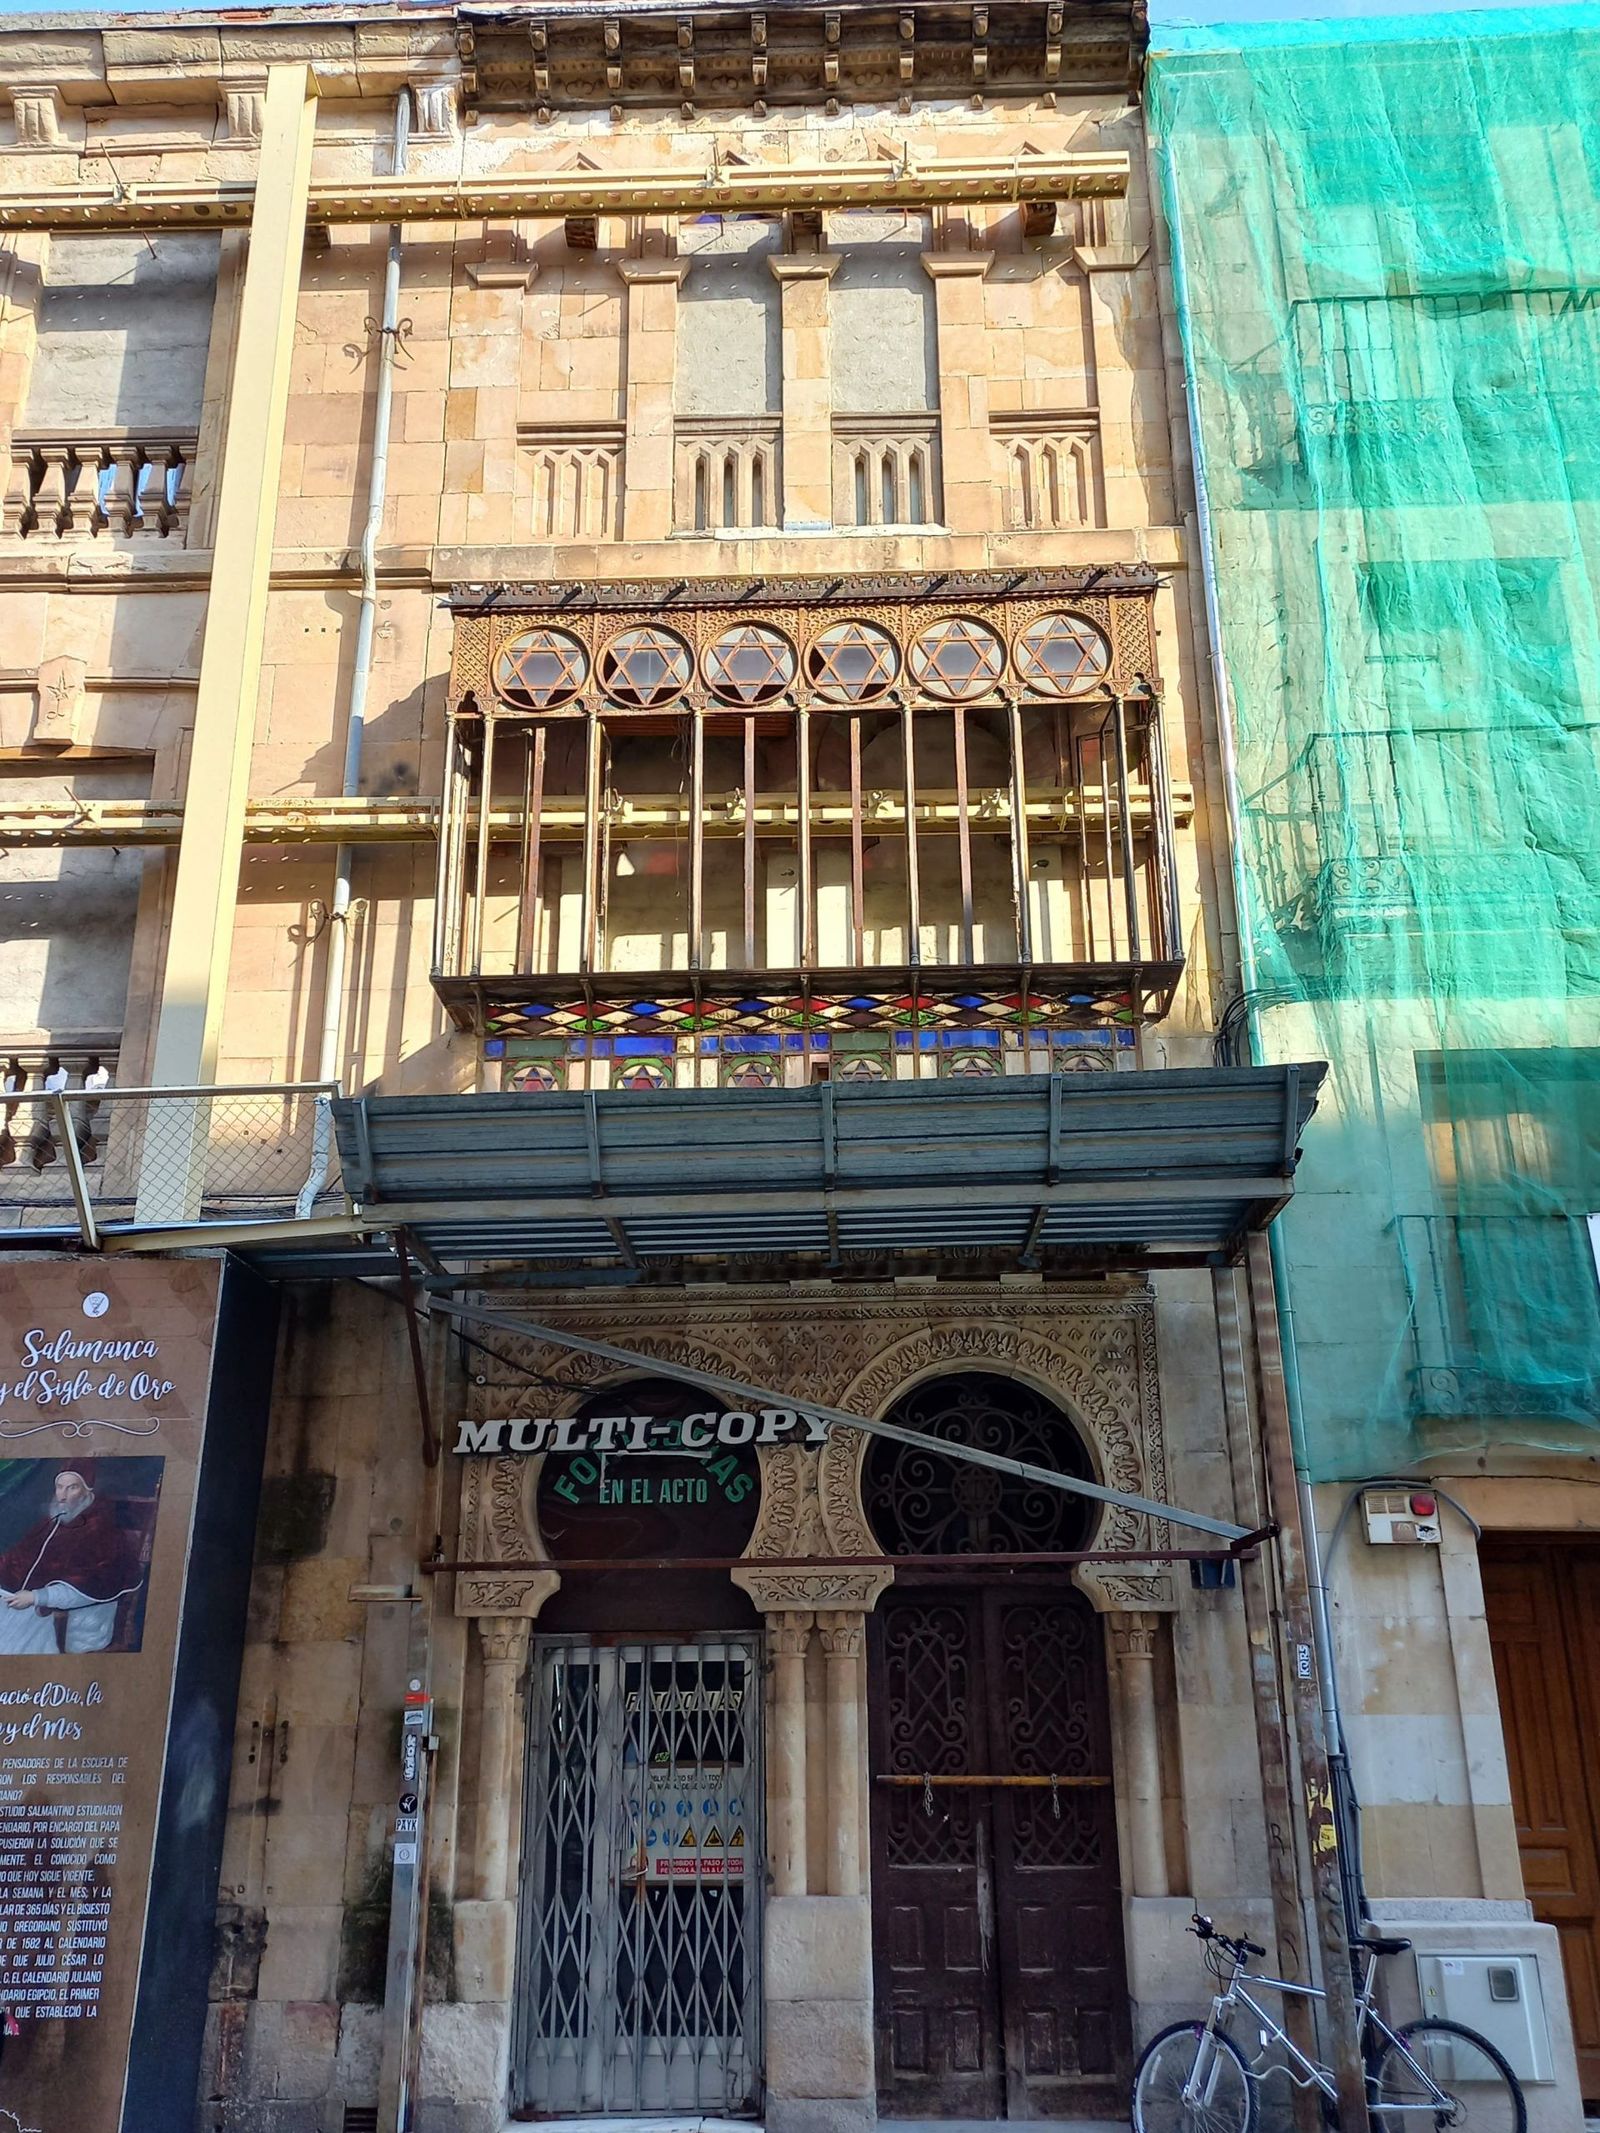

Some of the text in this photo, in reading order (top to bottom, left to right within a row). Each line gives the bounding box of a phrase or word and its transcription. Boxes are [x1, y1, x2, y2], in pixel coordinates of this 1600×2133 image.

[21, 1329, 158, 1368] Salamanca
[14, 1370, 38, 1400] el
[36, 1369, 95, 1406] Siglo
[98, 1373, 127, 1399] de
[130, 1371, 176, 1400] Oro
[453, 1409, 832, 1454] MULTI-COPY
[600, 1478, 708, 1504] EN EL ACTO
[0, 1688, 32, 1704] ació
[86, 1681, 103, 1706] la
[3, 1722, 21, 1745] y
[22, 1712, 41, 1738] el
[42, 1718, 82, 1740] Mes
[2, 1757, 128, 1769] PENSADORES DE LA ESCUELA DE
[22, 1773, 37, 1785] LOS
[111, 1773, 126, 1785] DEL
[27, 1805, 74, 1817] SALMANTINO
[76, 1805, 123, 1817] ESTUDIARON
[33, 1821, 48, 1833] POR
[49, 1821, 83, 1833] ENCARGO
[84, 1821, 97, 1833] DEL
[99, 1821, 120, 1833] PAPA
[0, 1835, 118, 1849] PUSIERON LA SOLUCIÓN QUE SE
[34, 1854, 43, 1865] EL
[51, 1854, 87, 1865] CONOCIDO
[94, 1854, 116, 1865] COMO
[7, 1870, 22, 1882] QUE
[23, 1870, 39, 1882] HOY
[40, 1870, 61, 1882] SIGUE
[12, 1887, 43, 1898] SEMANA
[48, 1887, 54, 1898] Y
[57, 1887, 66, 1898] EL
[92, 1887, 99, 1898] Y
[102, 1887, 112, 1898] LA
[15, 1903, 25, 1915] DE
[26, 1903, 41, 1915] 365
[60, 1903, 67, 1915] Y
[67, 1903, 76, 1915] EL
[77, 1903, 110, 1915] BISIESTO
[14, 1920, 60, 1932] GREGORIANO
[6, 1937, 17, 1949] DE
[44, 1937, 54, 1949] AL
[59, 1937, 106, 1949] CALENDARIO
[13, 1954, 29, 1966] QUE
[35, 1954, 55, 1966] JULIO
[61, 1952, 87, 1966] CÉSAR
[93, 1954, 104, 1966] LO
[12, 1971, 21, 1983] EL
[22, 1971, 70, 1983] CALENDARIO
[71, 1971, 102, 1983] JULIANO
[59, 1988, 69, 2000] EL
[70, 1988, 100, 2000] PRIMER
[15, 2005, 31, 2018] QUE
[36, 2003, 82, 2018] ESTABLECIÓ
[86, 2005, 97, 2018] LA
